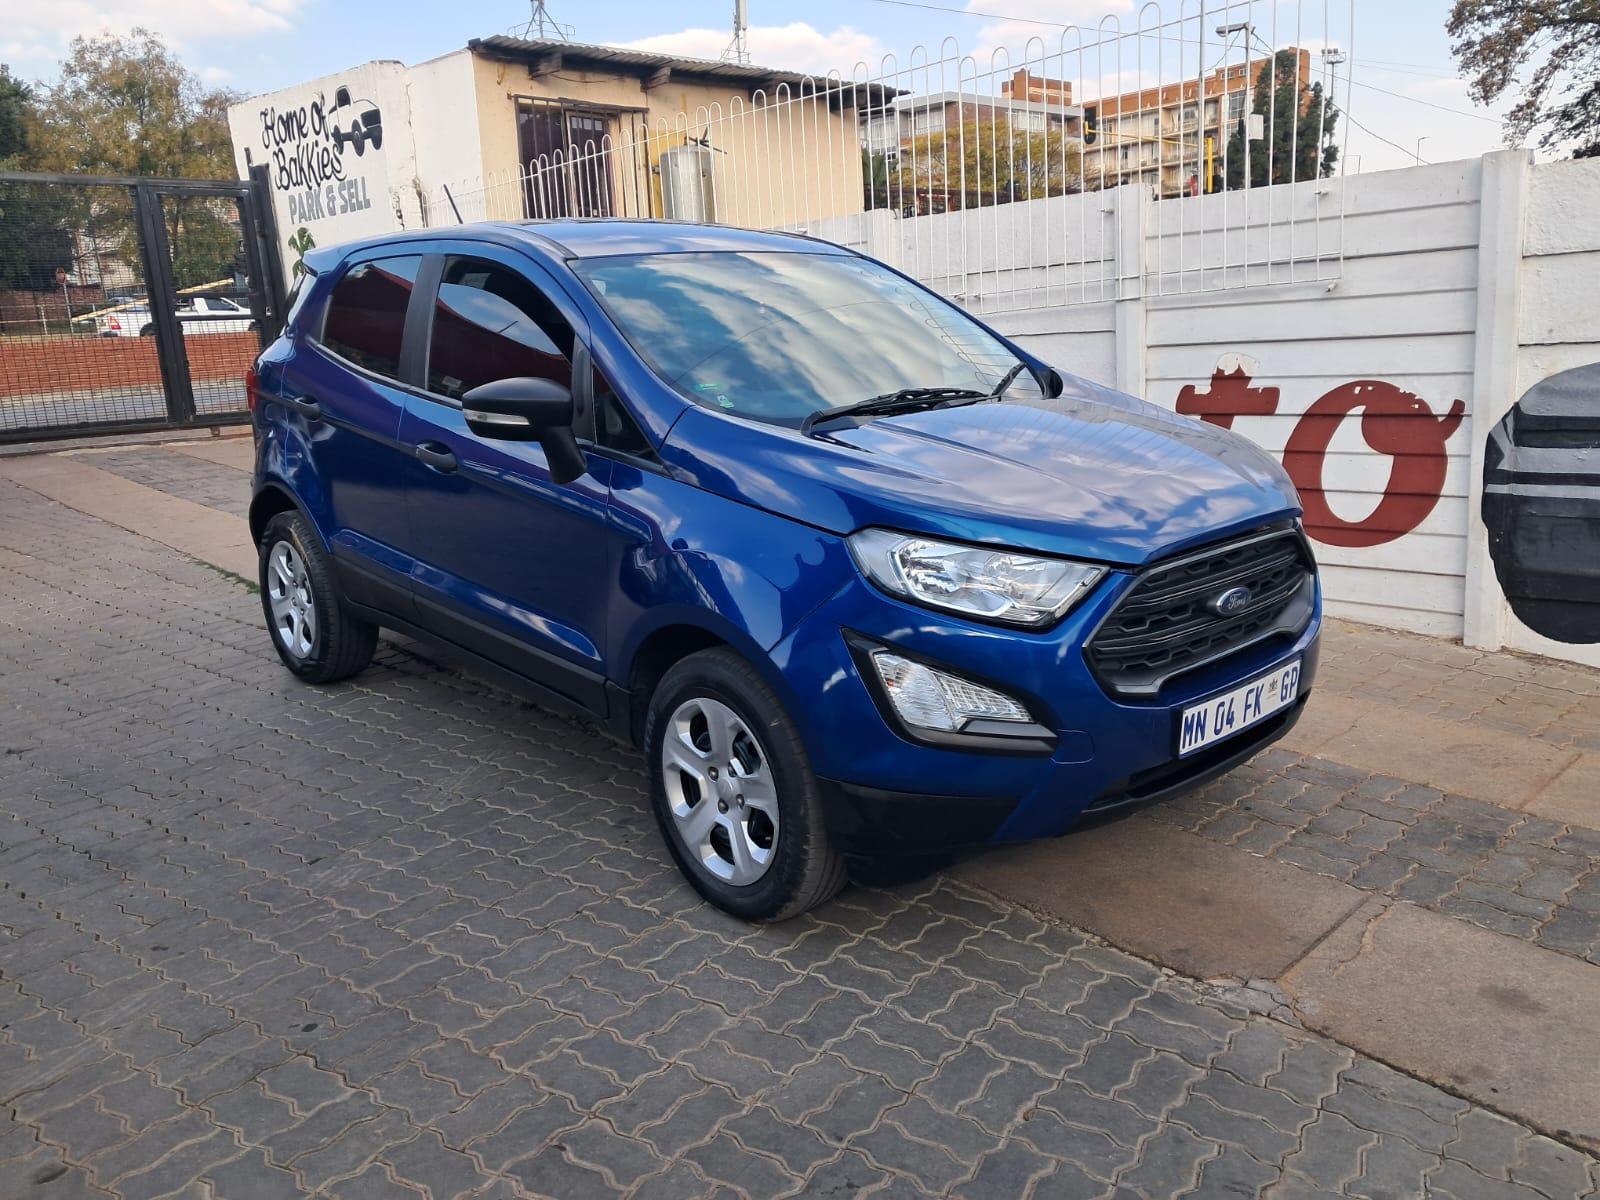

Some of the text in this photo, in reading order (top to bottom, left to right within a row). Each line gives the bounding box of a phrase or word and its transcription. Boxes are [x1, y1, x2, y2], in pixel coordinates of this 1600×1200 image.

[260, 107, 309, 149] Home
[288, 176, 371, 224] PARK & SELL
[1228, 592, 1247, 610] Ford
[1182, 666, 1299, 749] MN 04 FK GP
